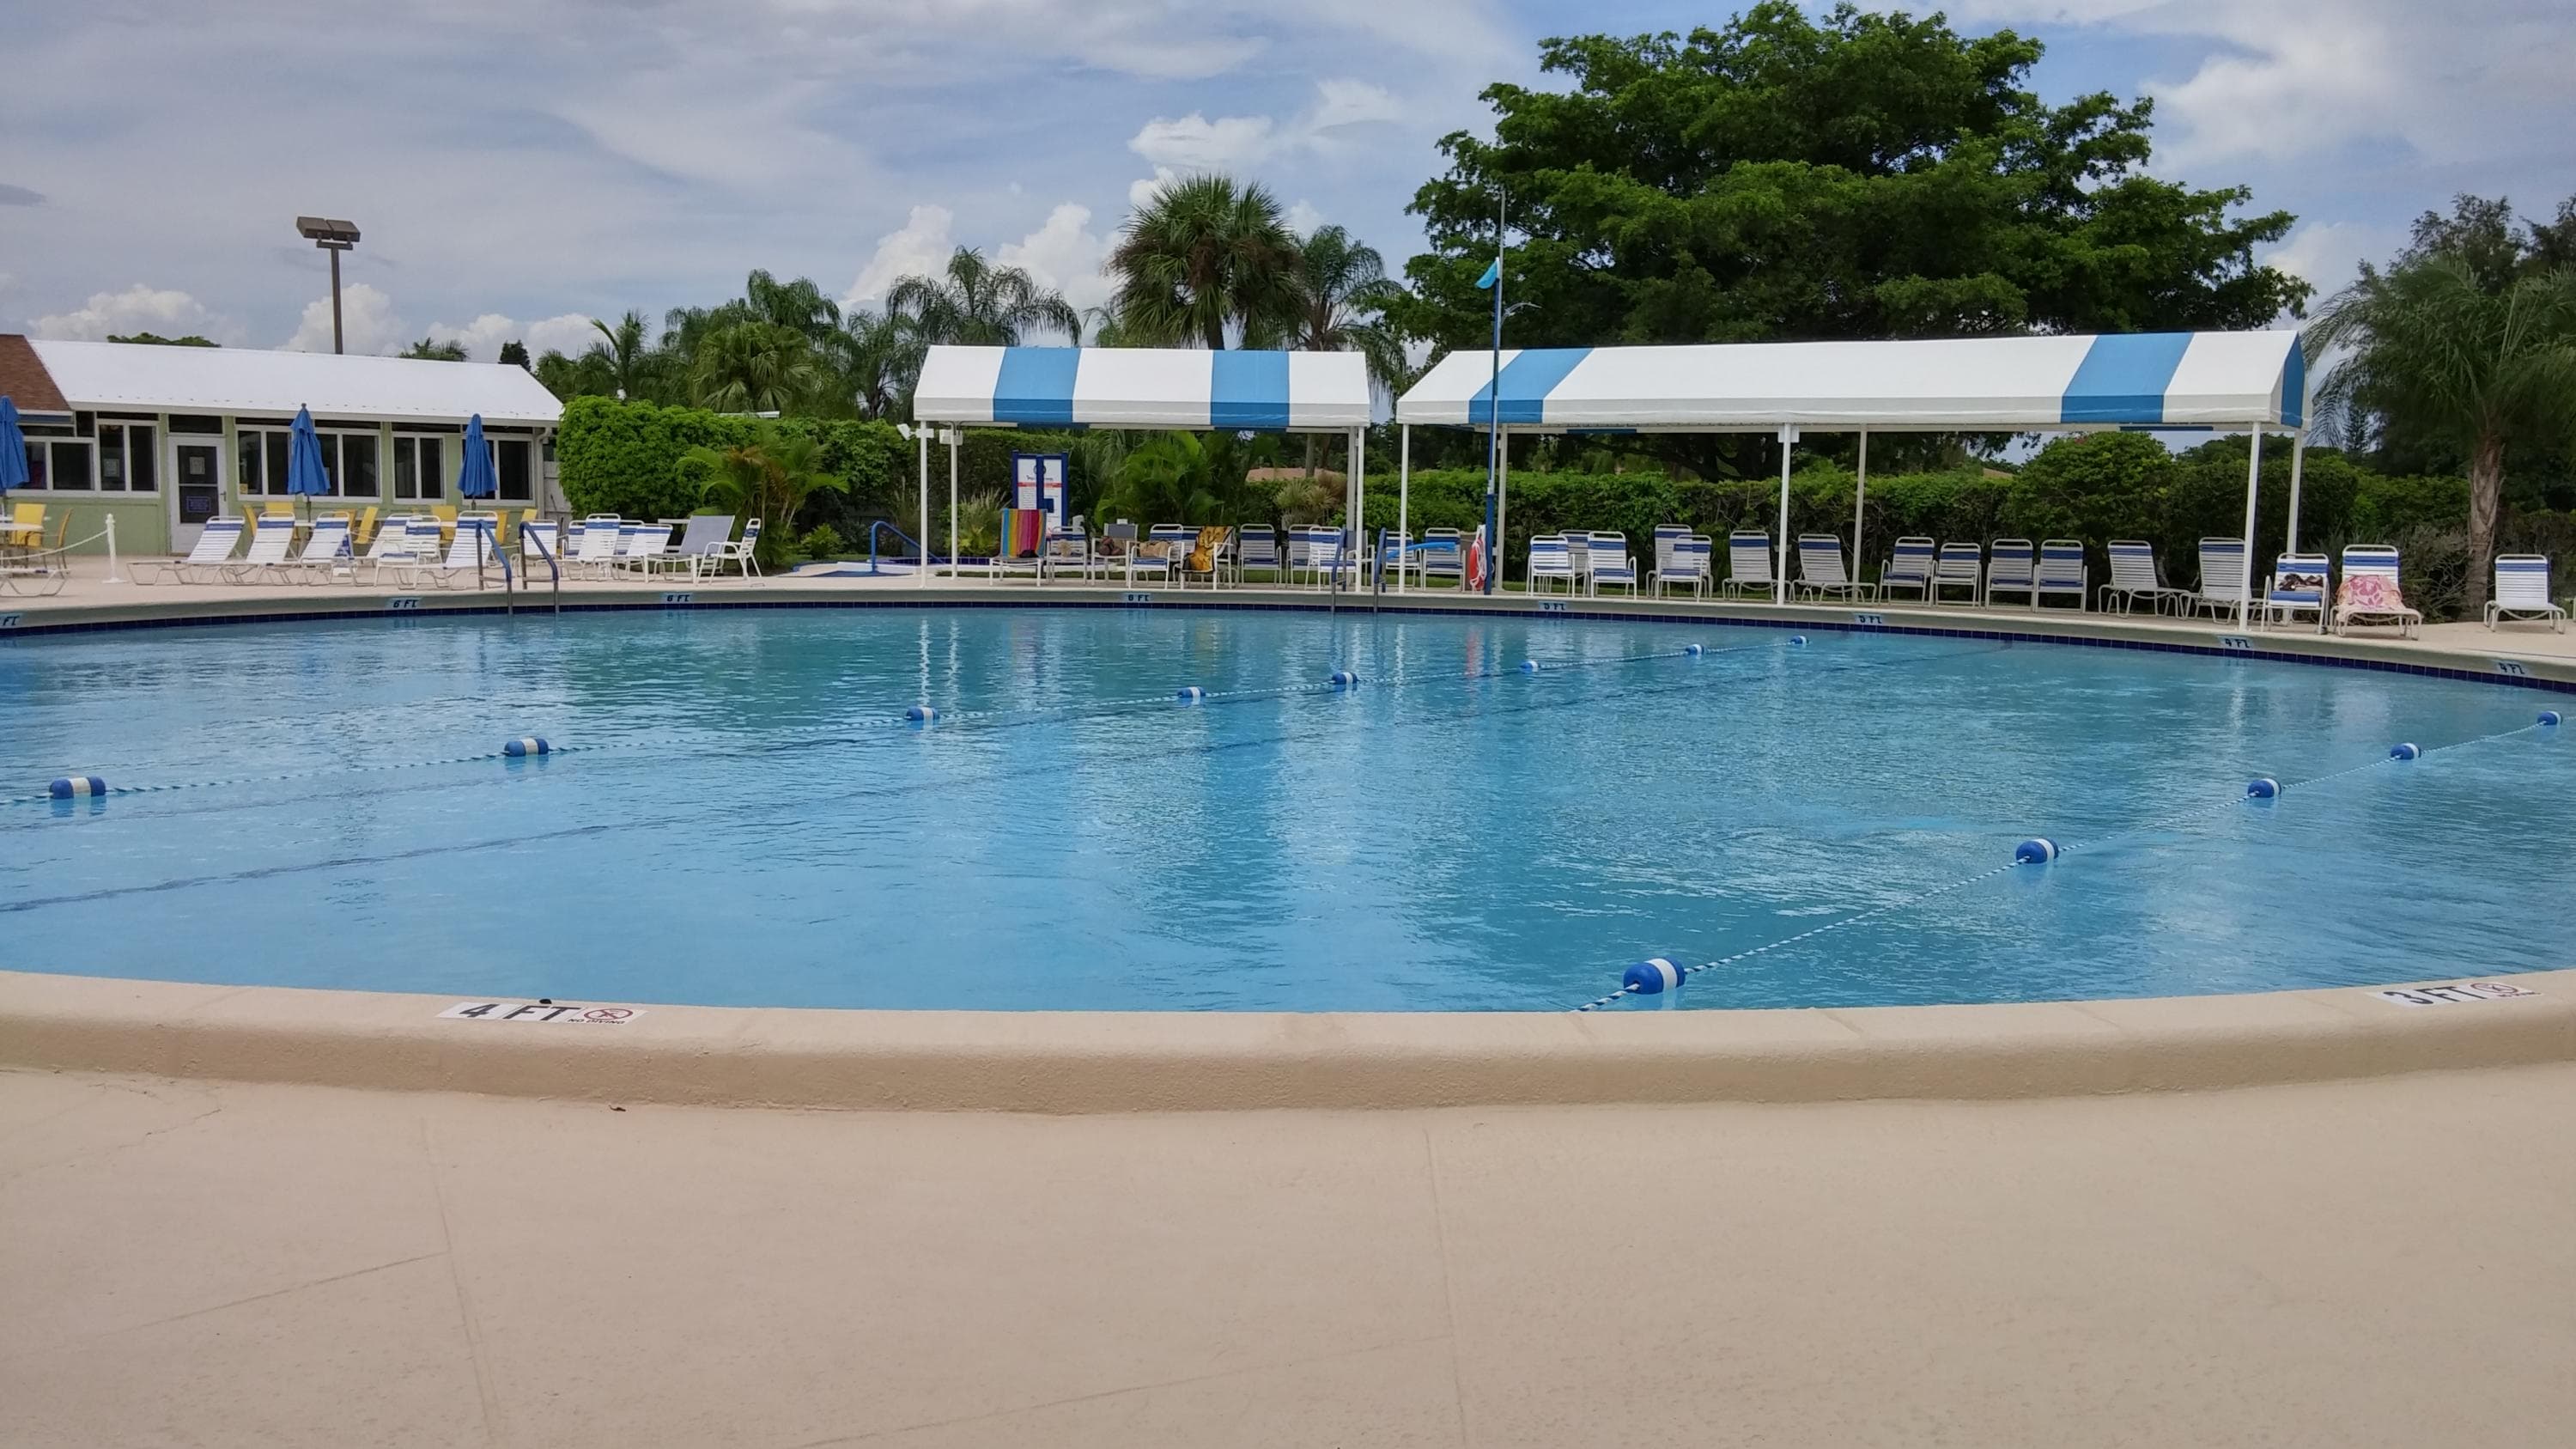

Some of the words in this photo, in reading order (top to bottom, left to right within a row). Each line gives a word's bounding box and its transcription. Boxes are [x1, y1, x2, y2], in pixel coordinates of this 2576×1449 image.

[393, 600, 400, 608] 6
[404, 600, 419, 608] FT
[3, 615, 20, 626] FT
[1870, 616, 1882, 624] FT
[2236, 639, 2250, 648] FT
[2508, 663, 2524, 674] FT
[2383, 991, 2433, 1005] 3
[2415, 986, 2488, 1002] FT
[459, 1003, 501, 1018] 4
[502, 1005, 581, 1021] FT
